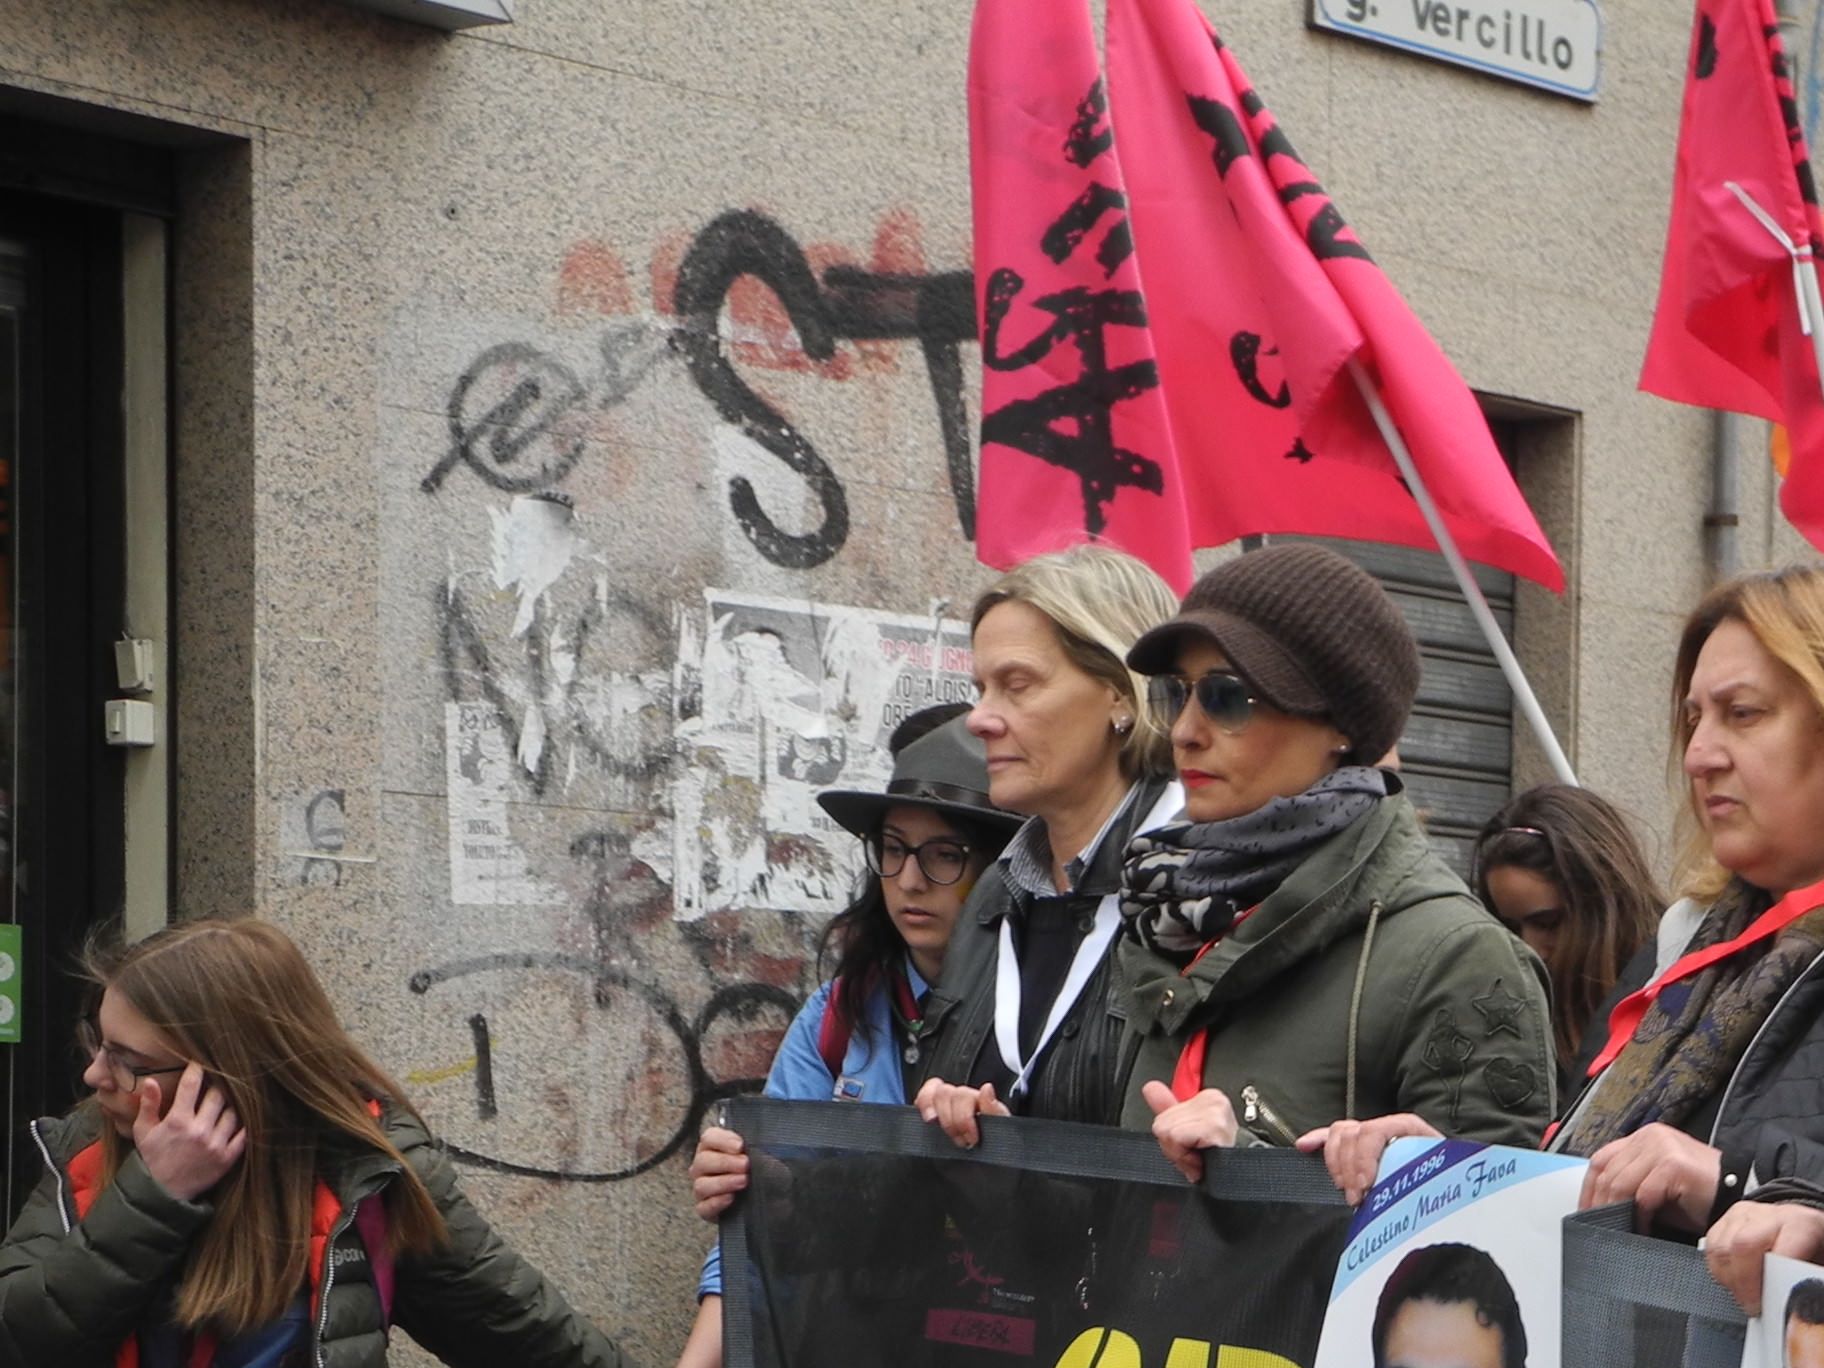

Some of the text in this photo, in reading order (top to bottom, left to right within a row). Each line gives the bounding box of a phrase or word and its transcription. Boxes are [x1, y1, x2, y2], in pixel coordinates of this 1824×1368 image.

[1413, 0, 1573, 70] Vercillo
[1346, 1158, 1517, 1272] Celestino Maria Fava
[1372, 1149, 1446, 1212] 29.11.1996
